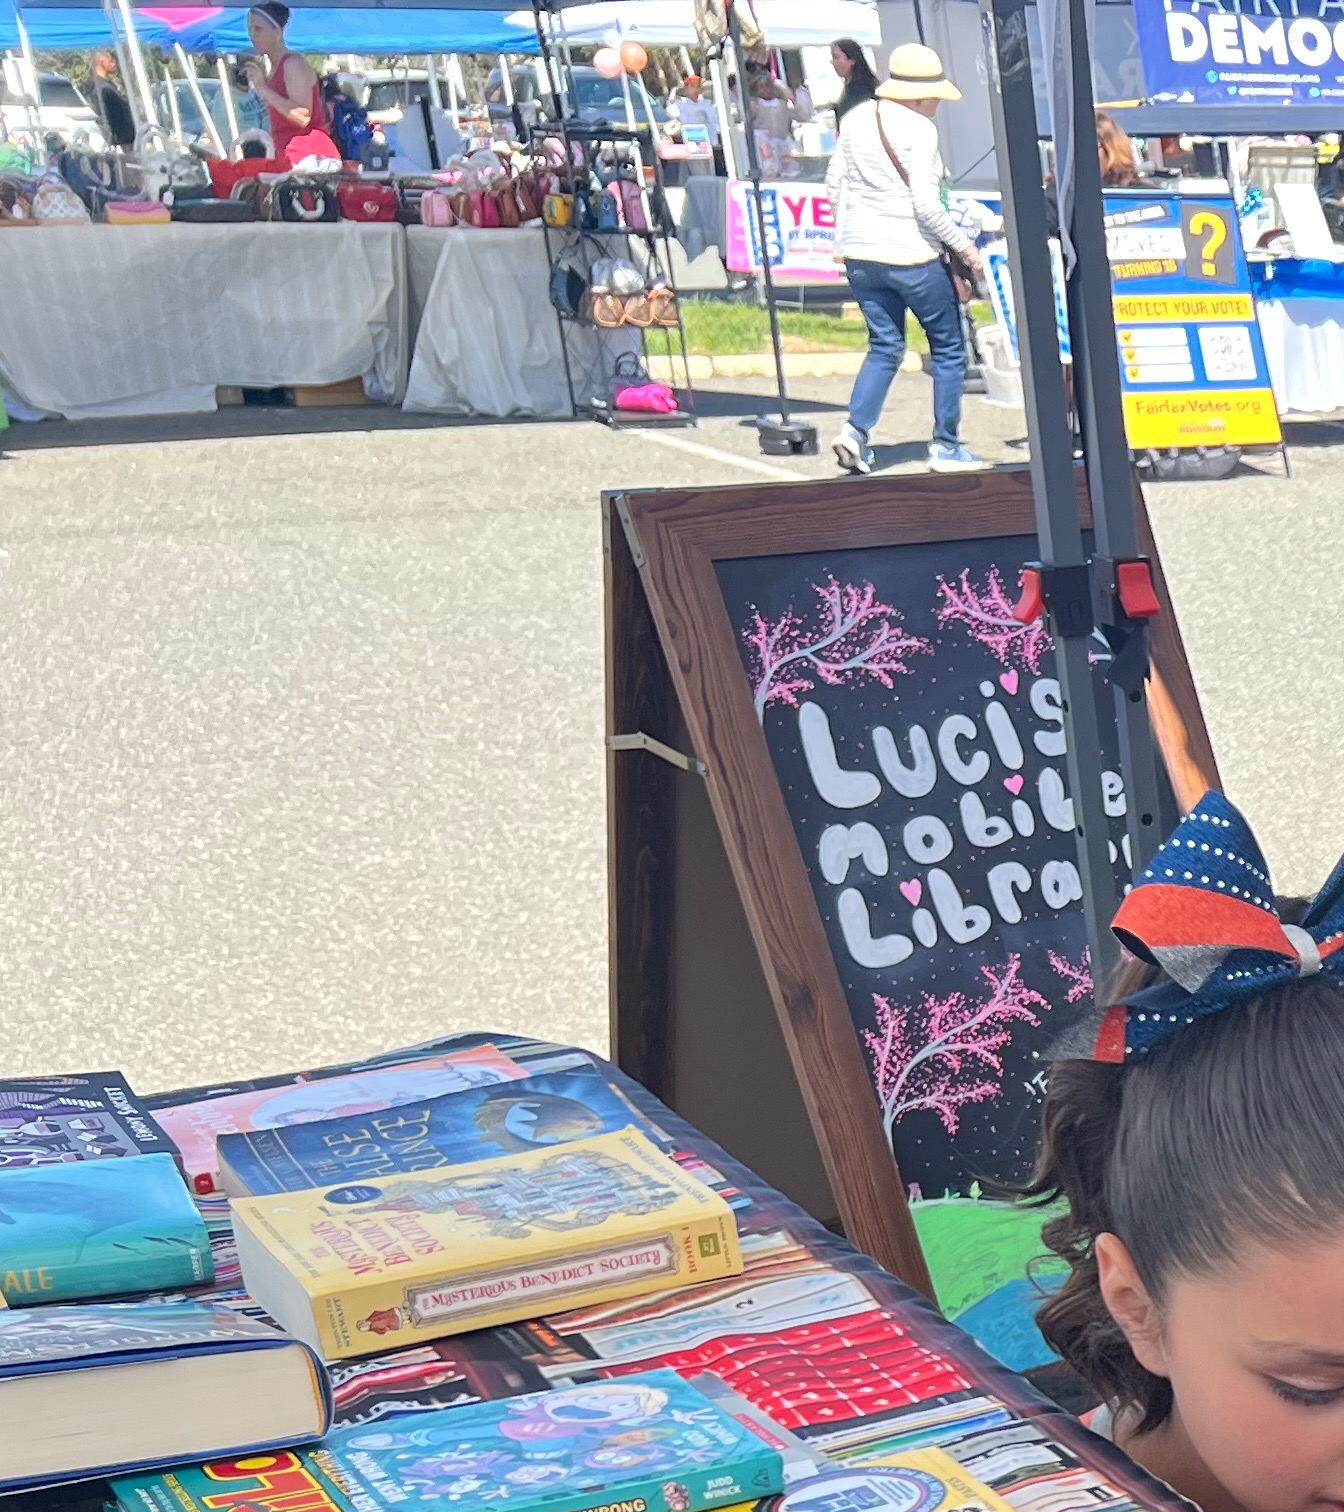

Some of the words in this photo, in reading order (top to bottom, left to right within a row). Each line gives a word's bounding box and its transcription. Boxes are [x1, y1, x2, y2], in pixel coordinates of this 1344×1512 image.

[782, 196, 836, 228] YE
[1174, 302, 1208, 314] YOUR
[1136, 399, 1262, 415] FairfaxVotes.org
[838, 836, 1133, 968] Libra
[431, 1279, 517, 1308] MYSTERIOUS
[518, 1261, 595, 1289] BENEDICT
[599, 1247, 663, 1273] SOCIETY
[706, 1476, 735, 1490] JUDD
[703, 1485, 743, 1500] WINICK
